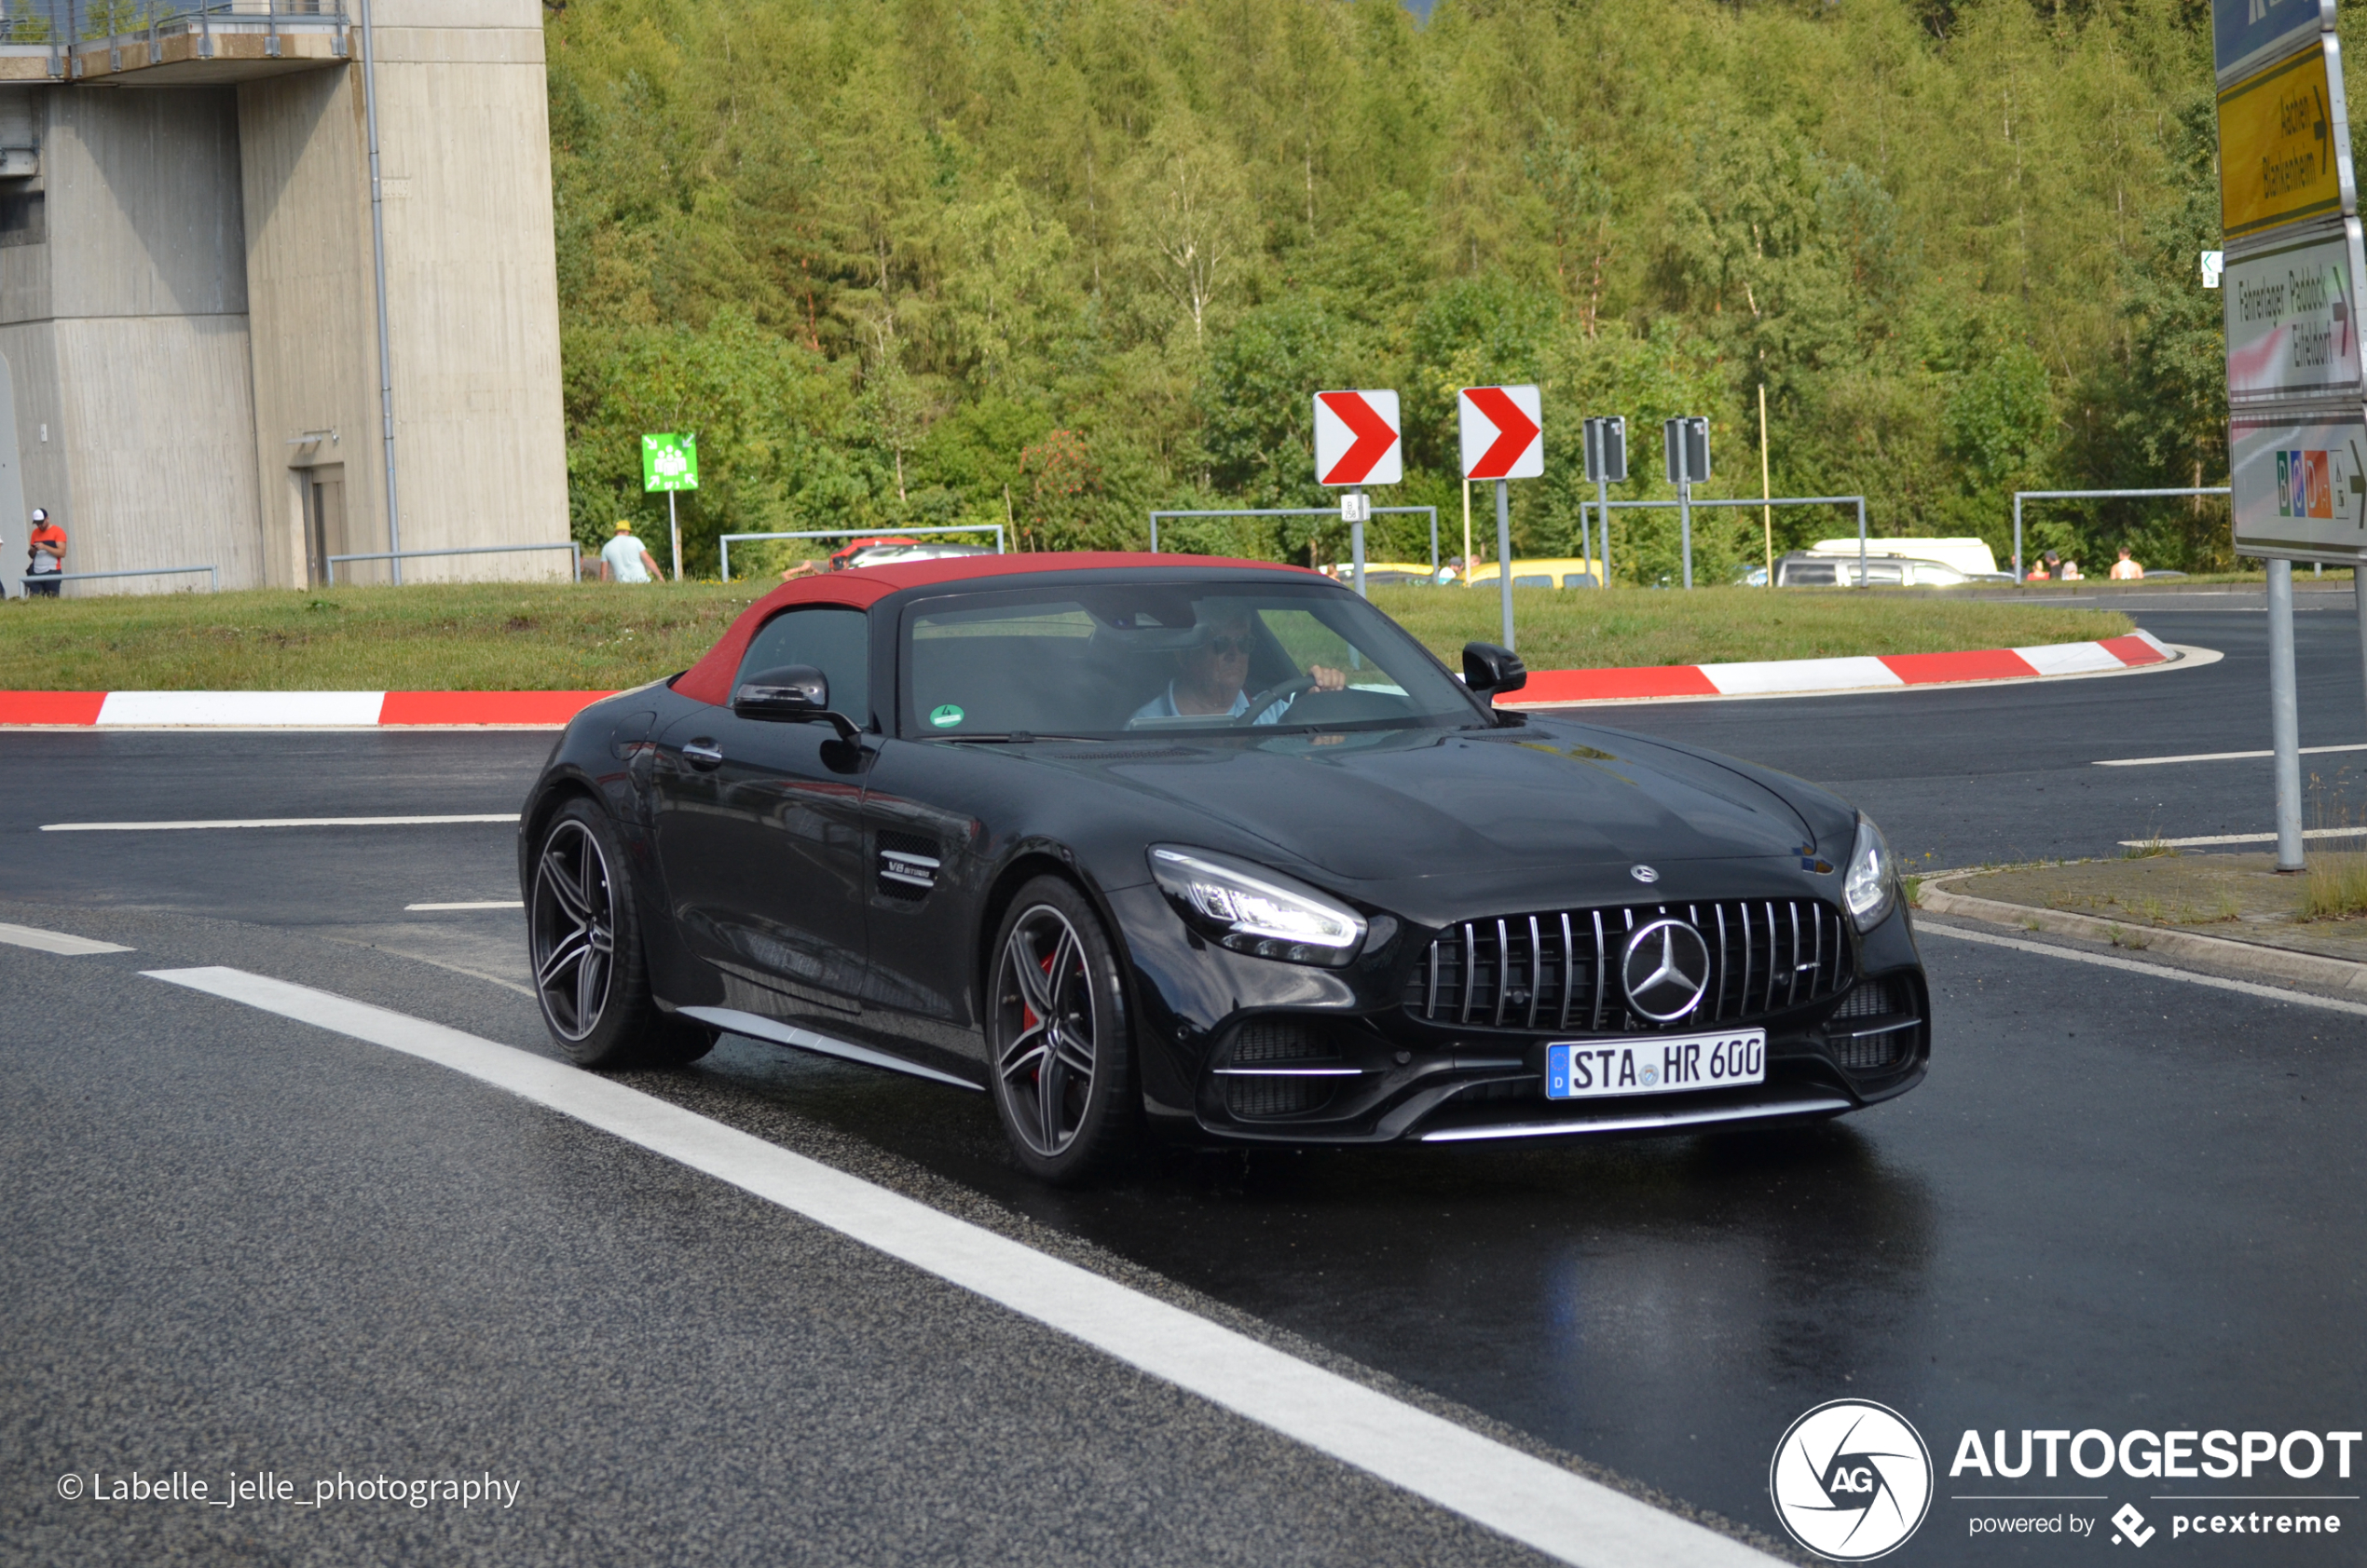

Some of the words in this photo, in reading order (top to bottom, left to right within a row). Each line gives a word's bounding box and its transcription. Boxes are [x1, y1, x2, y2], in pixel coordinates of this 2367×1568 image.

[2279, 89, 2312, 139] Aachen
[2263, 143, 2317, 199] Blankenheim
[2238, 276, 2285, 329] Fahrerlager
[2289, 264, 2329, 314] Paddock
[2292, 319, 2333, 368] Eifeldorf
[1347, 501, 1353, 511] B
[2278, 459, 2289, 508] B
[2292, 458, 2303, 509] C
[2306, 459, 2318, 509] D
[941, 705, 952, 716] 4
[888, 861, 904, 873] V8
[904, 867, 930, 878] BITURBO
[1554, 1076, 1564, 1089] D
[1574, 1048, 1636, 1089] STA
[1663, 1043, 1701, 1084] HR
[1710, 1038, 1761, 1079] 600
